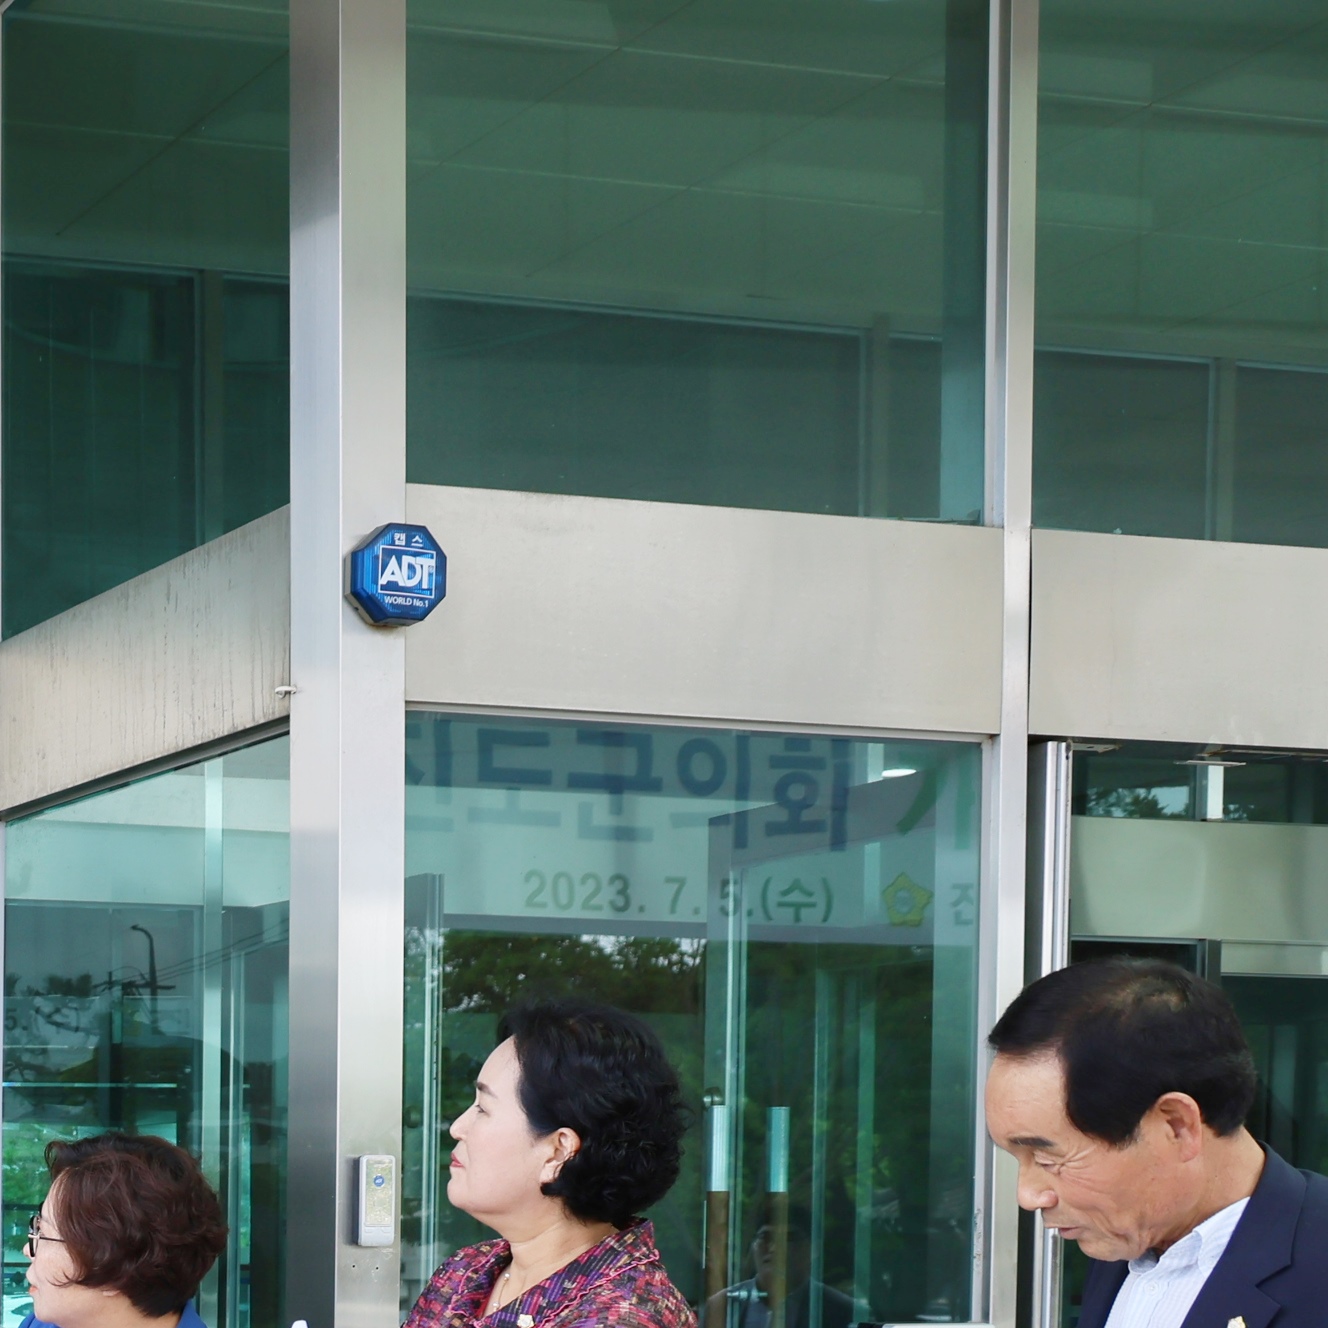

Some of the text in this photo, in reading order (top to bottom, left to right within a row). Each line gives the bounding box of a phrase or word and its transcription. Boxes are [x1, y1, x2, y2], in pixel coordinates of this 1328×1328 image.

[393, 532, 424, 546] 캡스
[380, 554, 435, 589] ADT
[384, 595, 429, 608] WORLD No.1
[523, 868, 646, 913] 2023.
[664, 875, 701, 917] 7.
